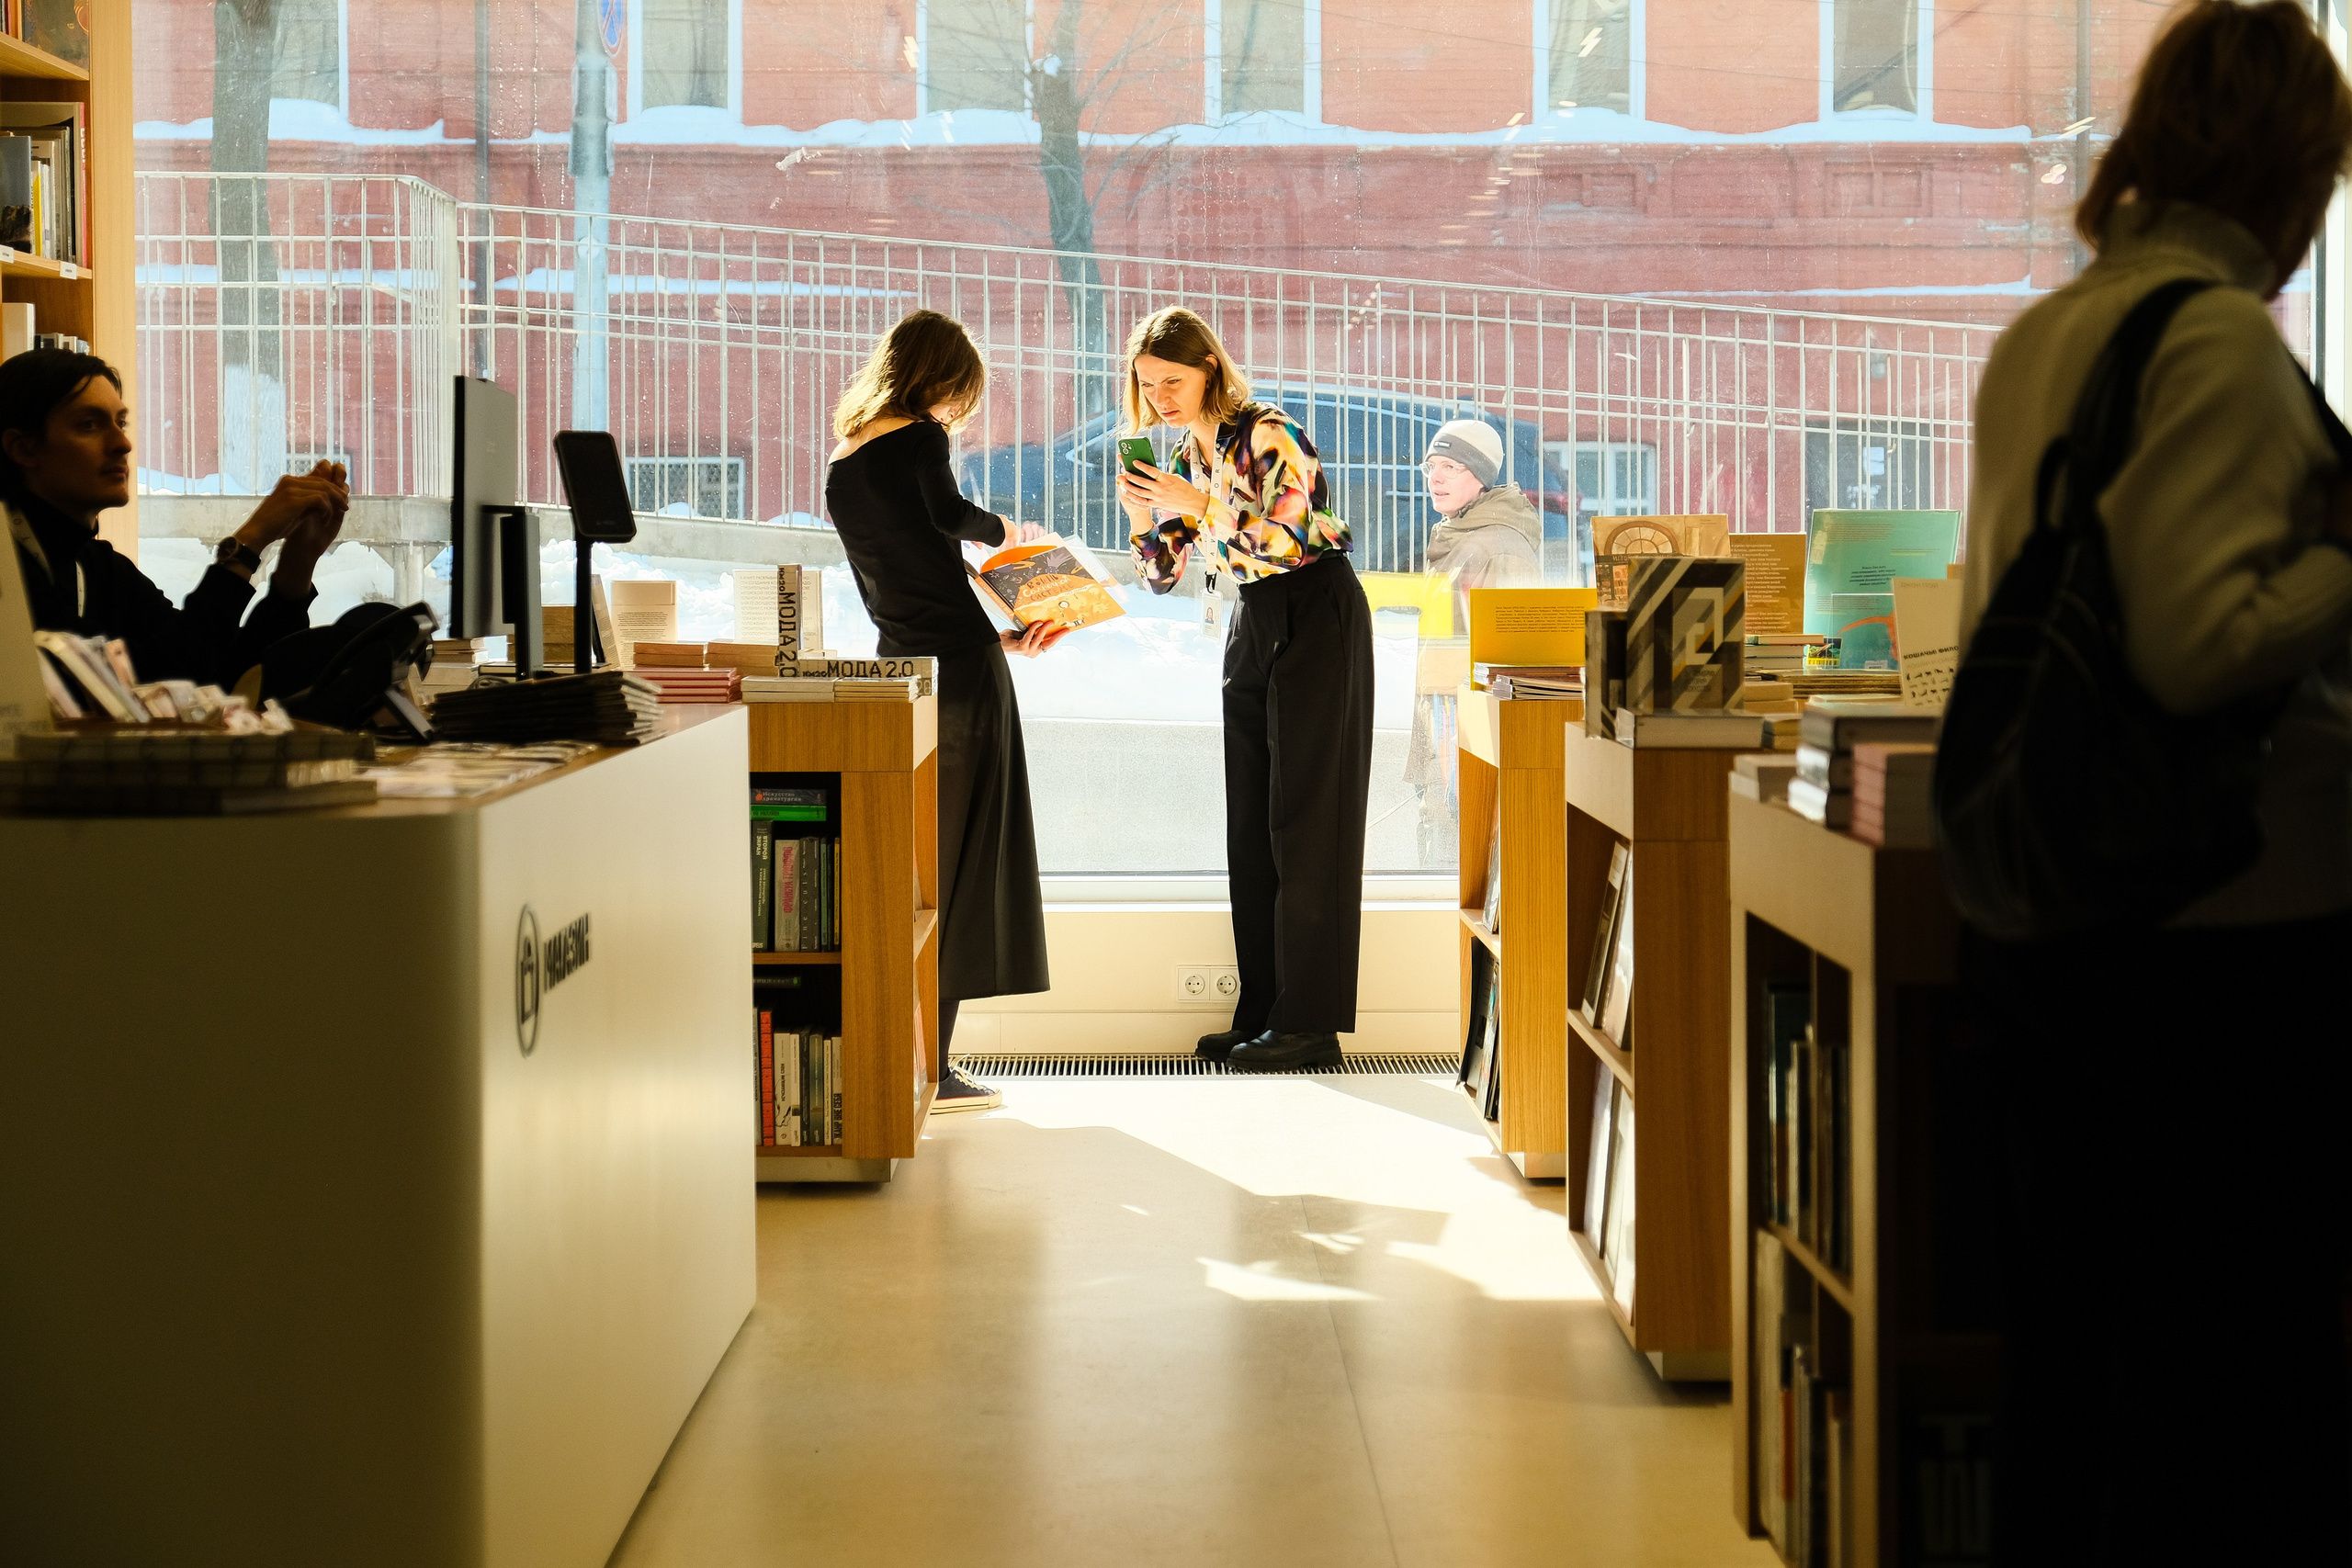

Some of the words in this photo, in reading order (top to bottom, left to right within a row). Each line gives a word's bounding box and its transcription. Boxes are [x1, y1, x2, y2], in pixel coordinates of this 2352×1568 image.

[778, 592, 796, 647] МОДА
[779, 650, 797, 677] 2.0
[827, 661, 882, 678] МОДА
[885, 661, 915, 678] 2.0
[783, 882, 793, 913] ФРАНСУА
[833, 1093, 842, 1109] СЕБЯ
[833, 1109, 842, 1121] ВНЕ
[833, 1121, 842, 1139] ЖАНР
